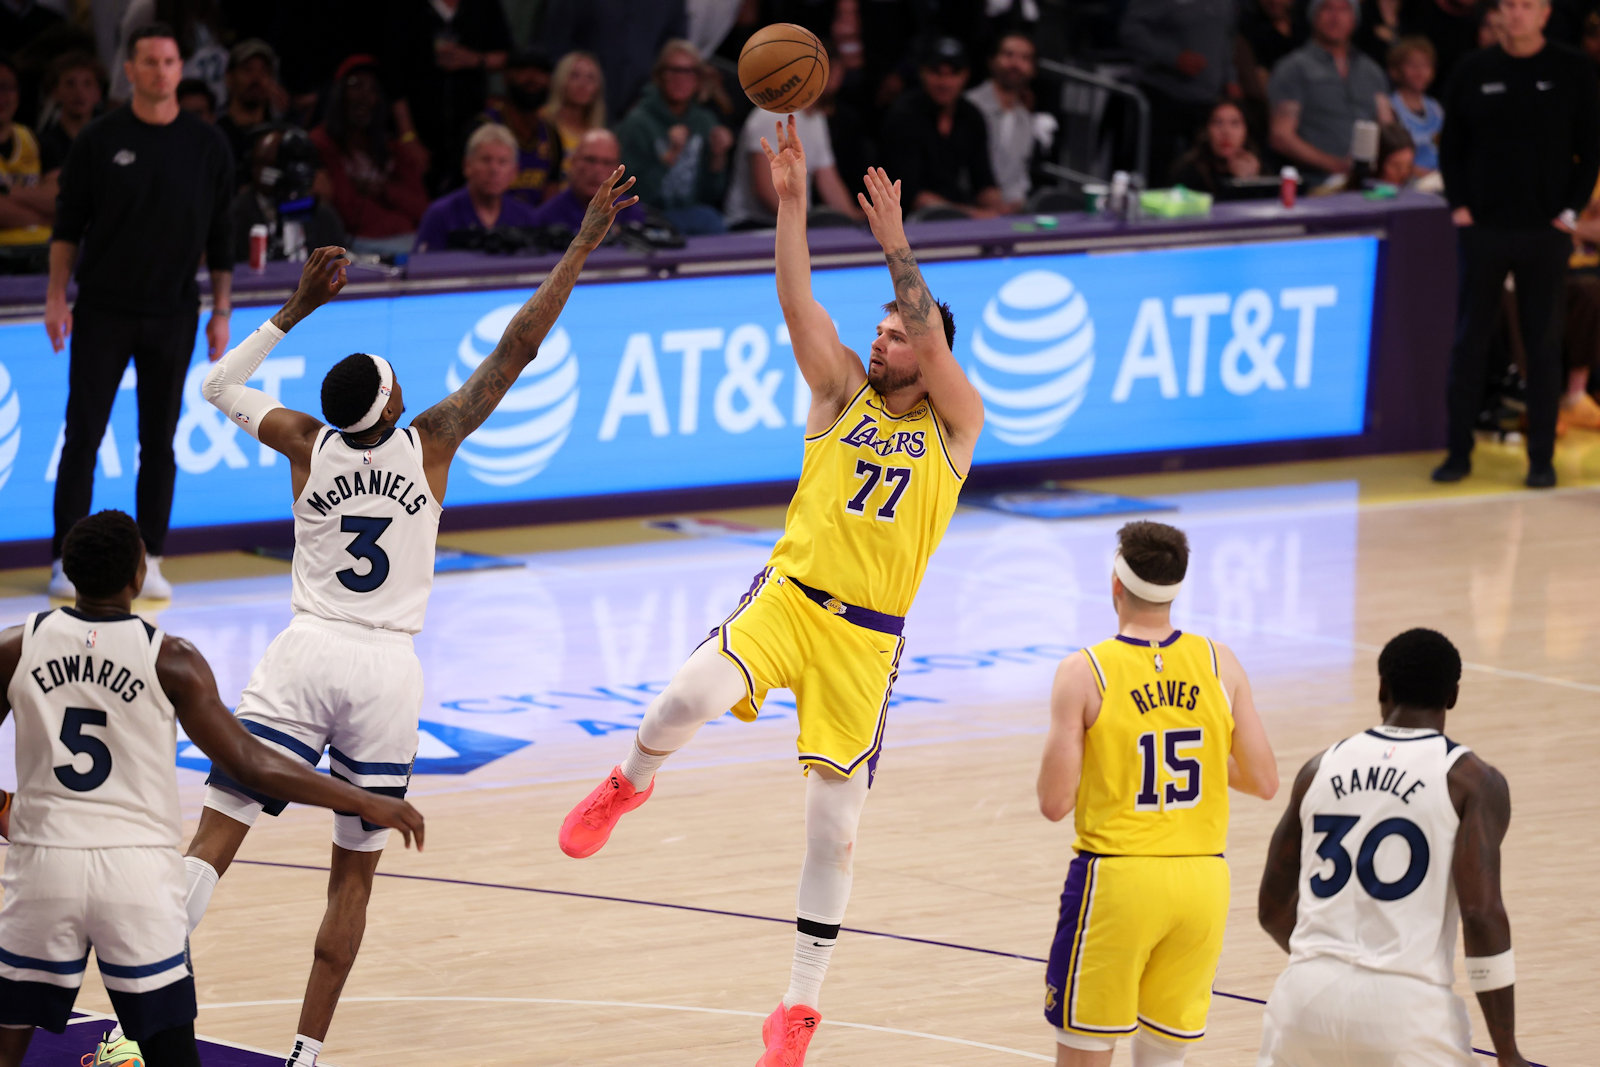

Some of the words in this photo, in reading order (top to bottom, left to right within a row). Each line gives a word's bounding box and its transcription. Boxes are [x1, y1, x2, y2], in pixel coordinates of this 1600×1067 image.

[1111, 284, 1338, 403] AT&T
[307, 469, 427, 517] McDANIELS
[844, 457, 912, 524] 77
[335, 514, 393, 593] 3
[31, 655, 145, 703] EDWARDS
[1130, 680, 1200, 715] REAVES
[53, 706, 113, 793] 5
[1134, 727, 1204, 812] 15
[1330, 765, 1426, 805] RANDLE
[1309, 814, 1430, 902] 30
